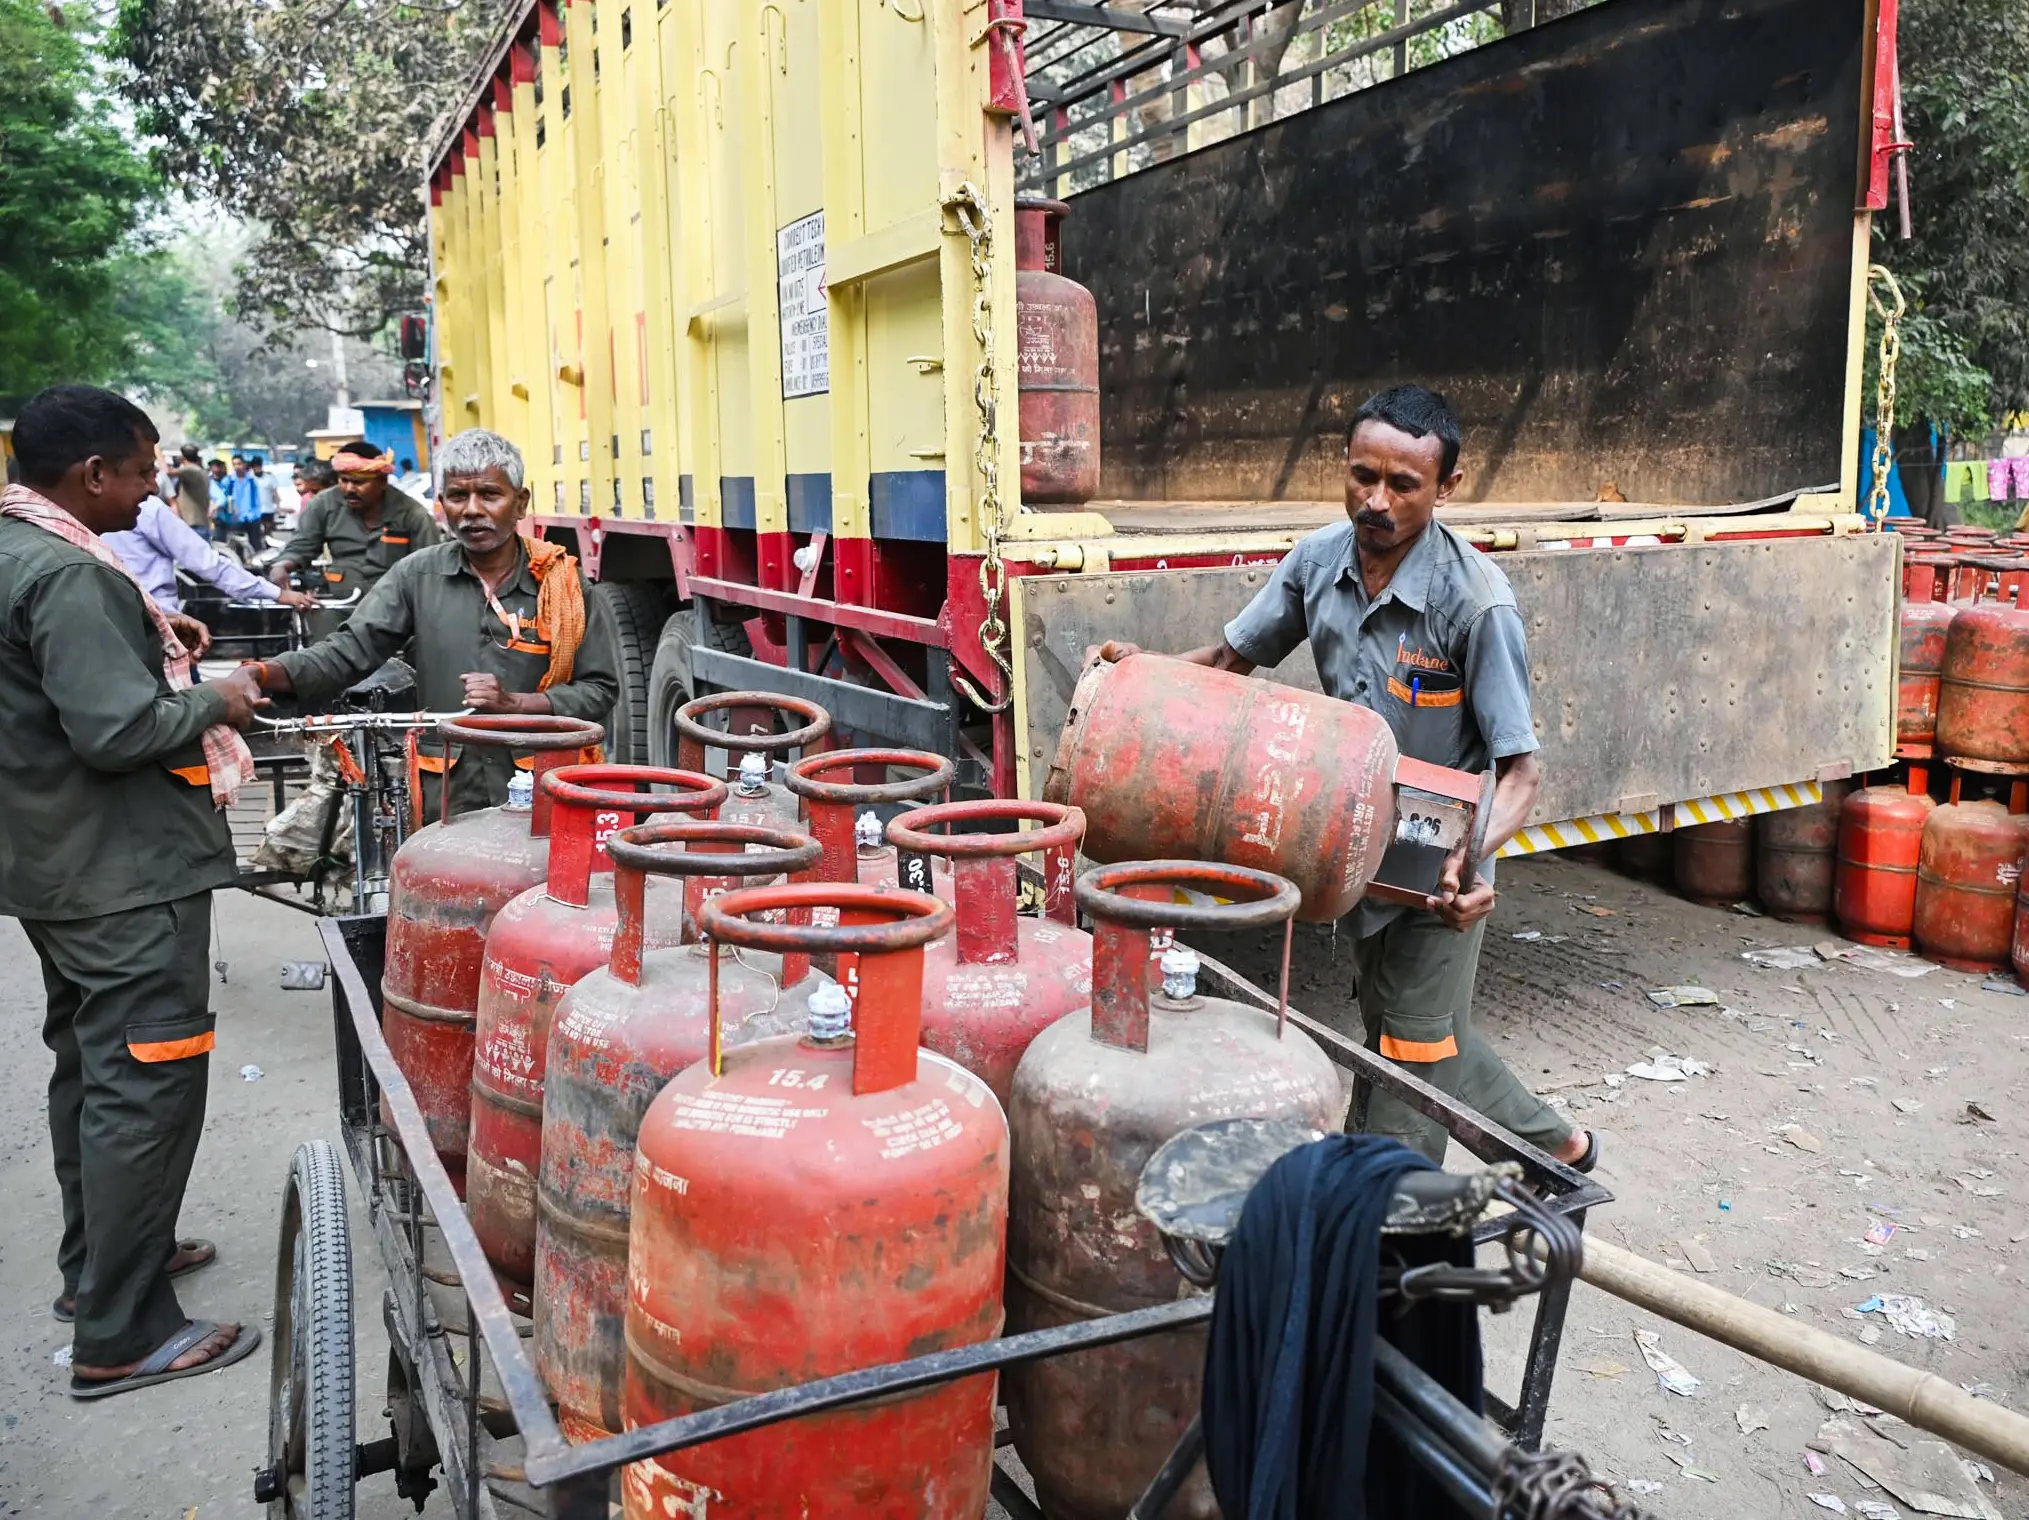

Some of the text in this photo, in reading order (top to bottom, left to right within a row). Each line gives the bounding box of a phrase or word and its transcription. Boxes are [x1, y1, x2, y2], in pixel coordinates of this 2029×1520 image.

[1045, 242, 1055, 269] 15.6
[1397, 632, 1449, 671] Indane
[768, 1068, 829, 1091] 15.4
[781, 1108, 801, 1118] USE
[802, 1108, 829, 1118] ONLY
